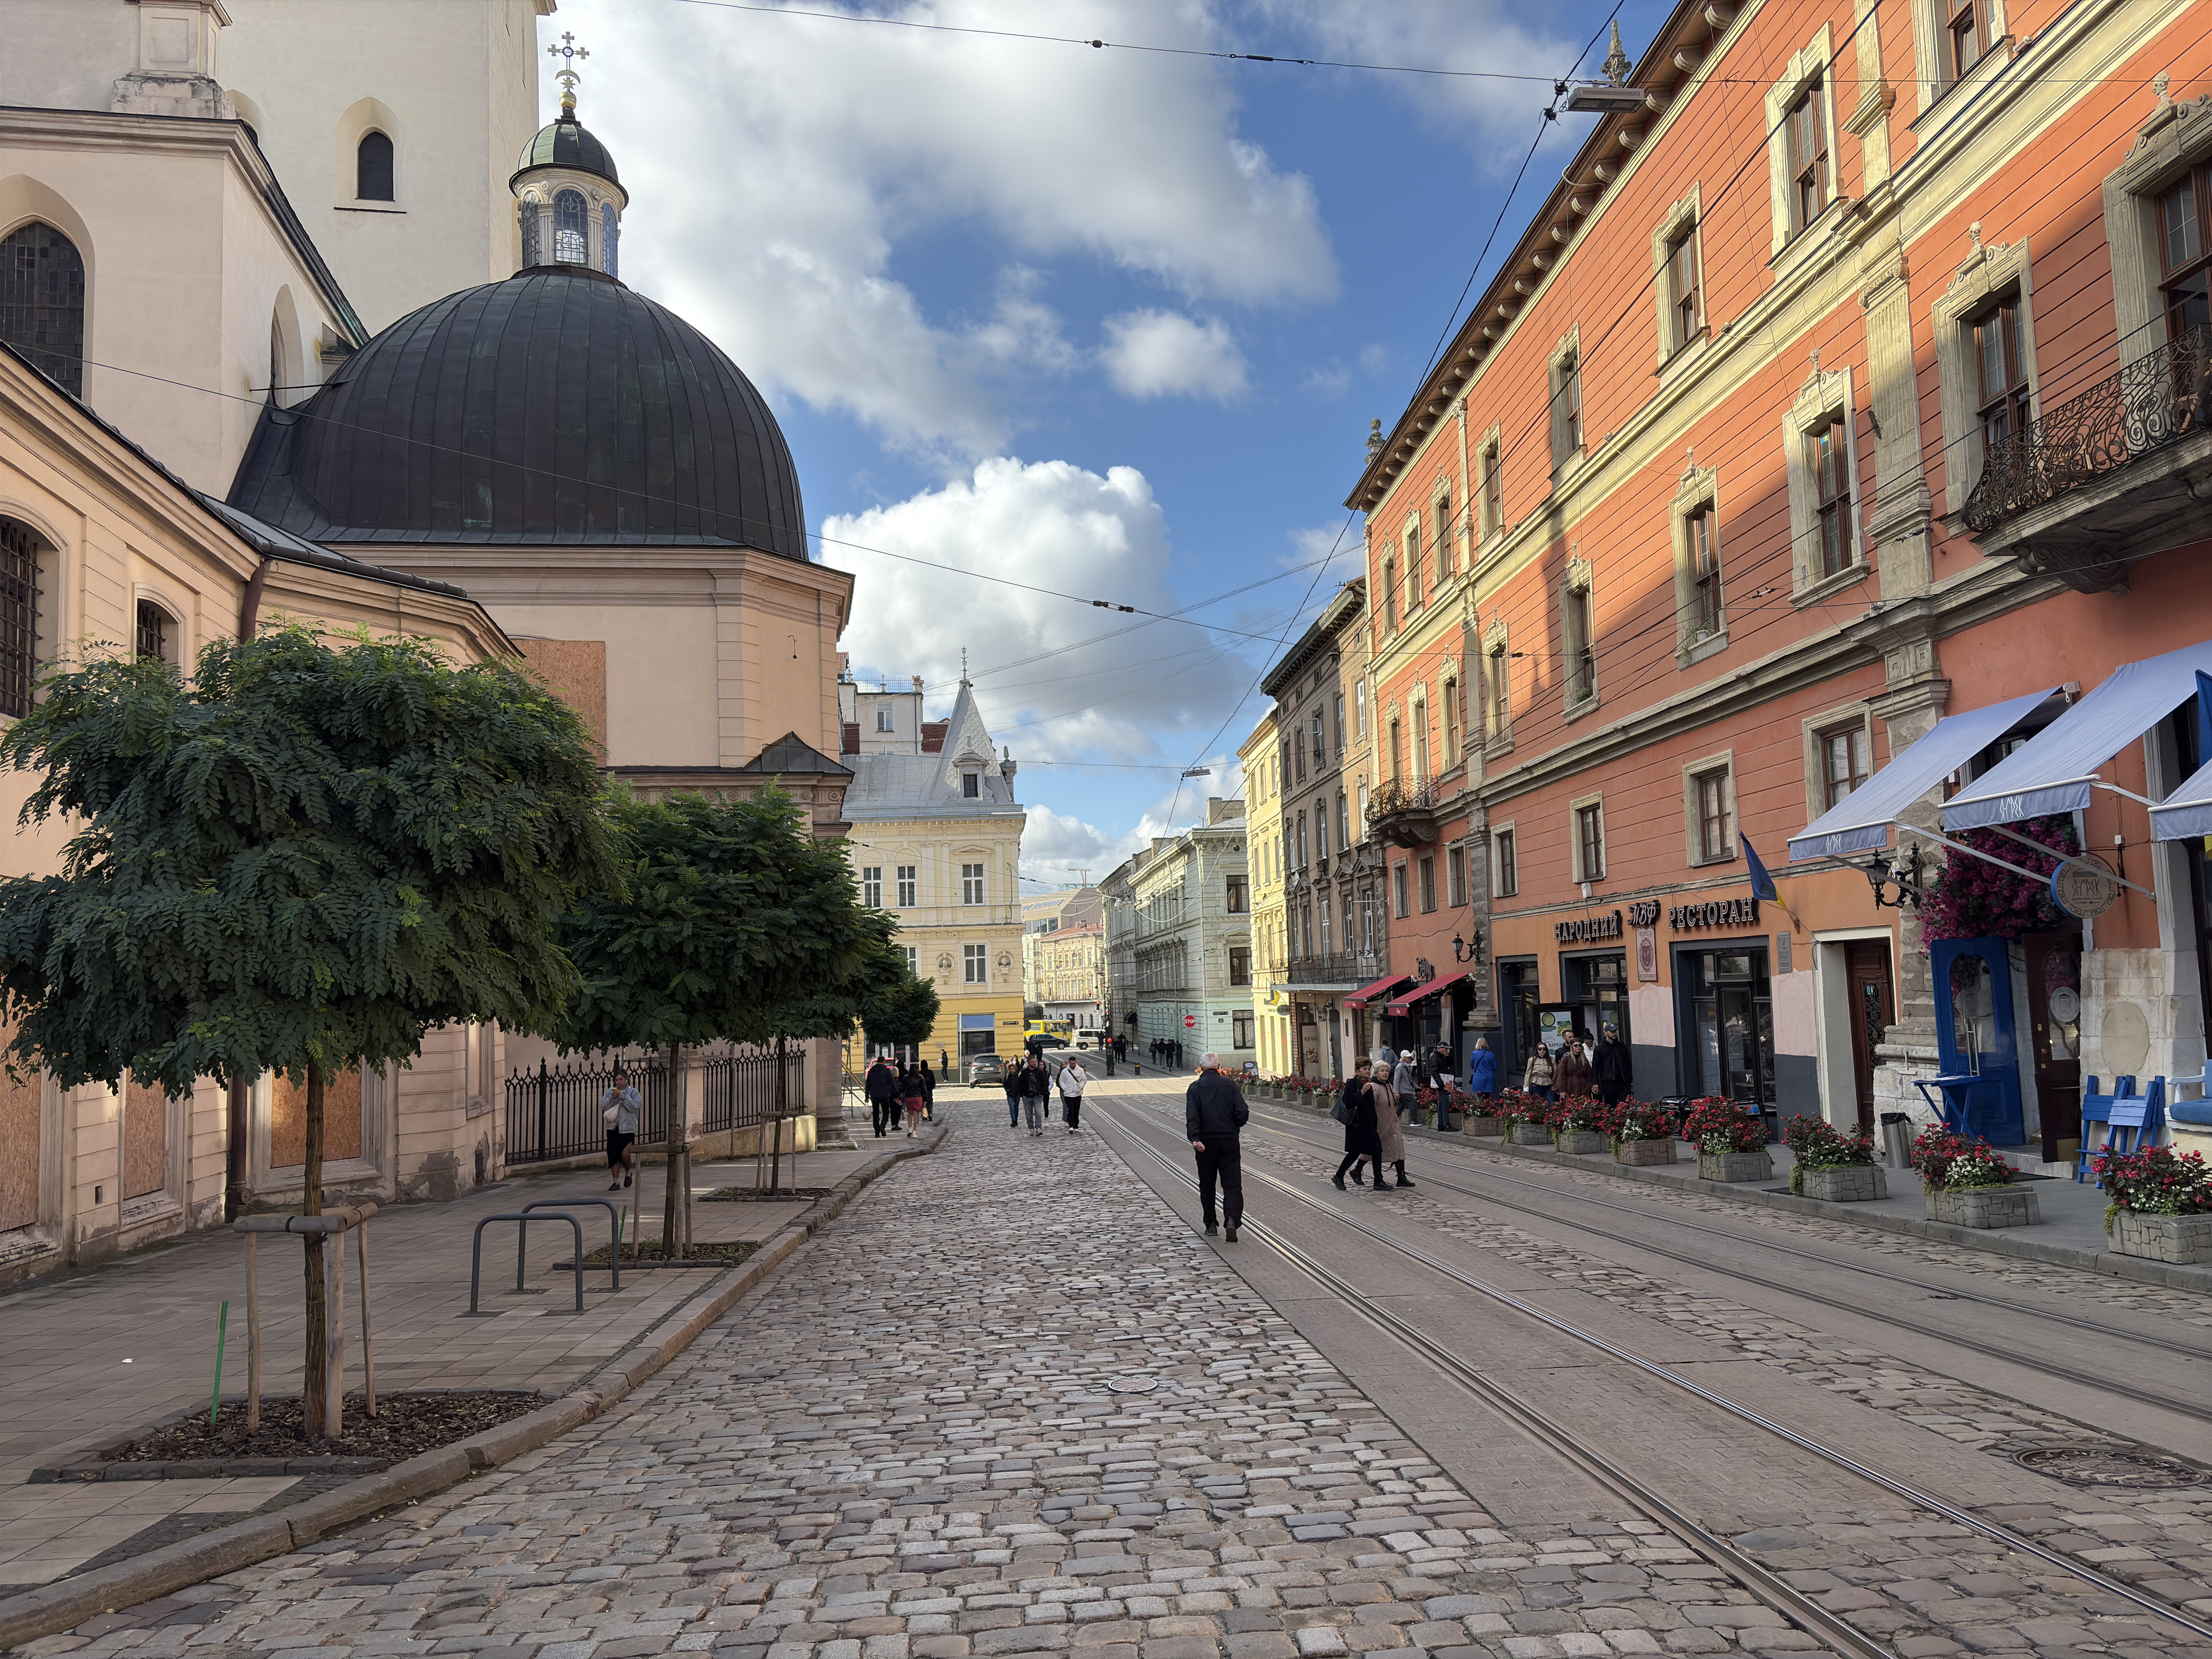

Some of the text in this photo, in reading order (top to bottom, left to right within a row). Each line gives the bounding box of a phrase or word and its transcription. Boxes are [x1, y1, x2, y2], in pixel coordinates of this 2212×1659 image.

[1891, 869, 1896, 879] 3
[1553, 909, 1619, 941] НАРОДНИЙ
[1667, 896, 1755, 929] РЕСТОРАН
